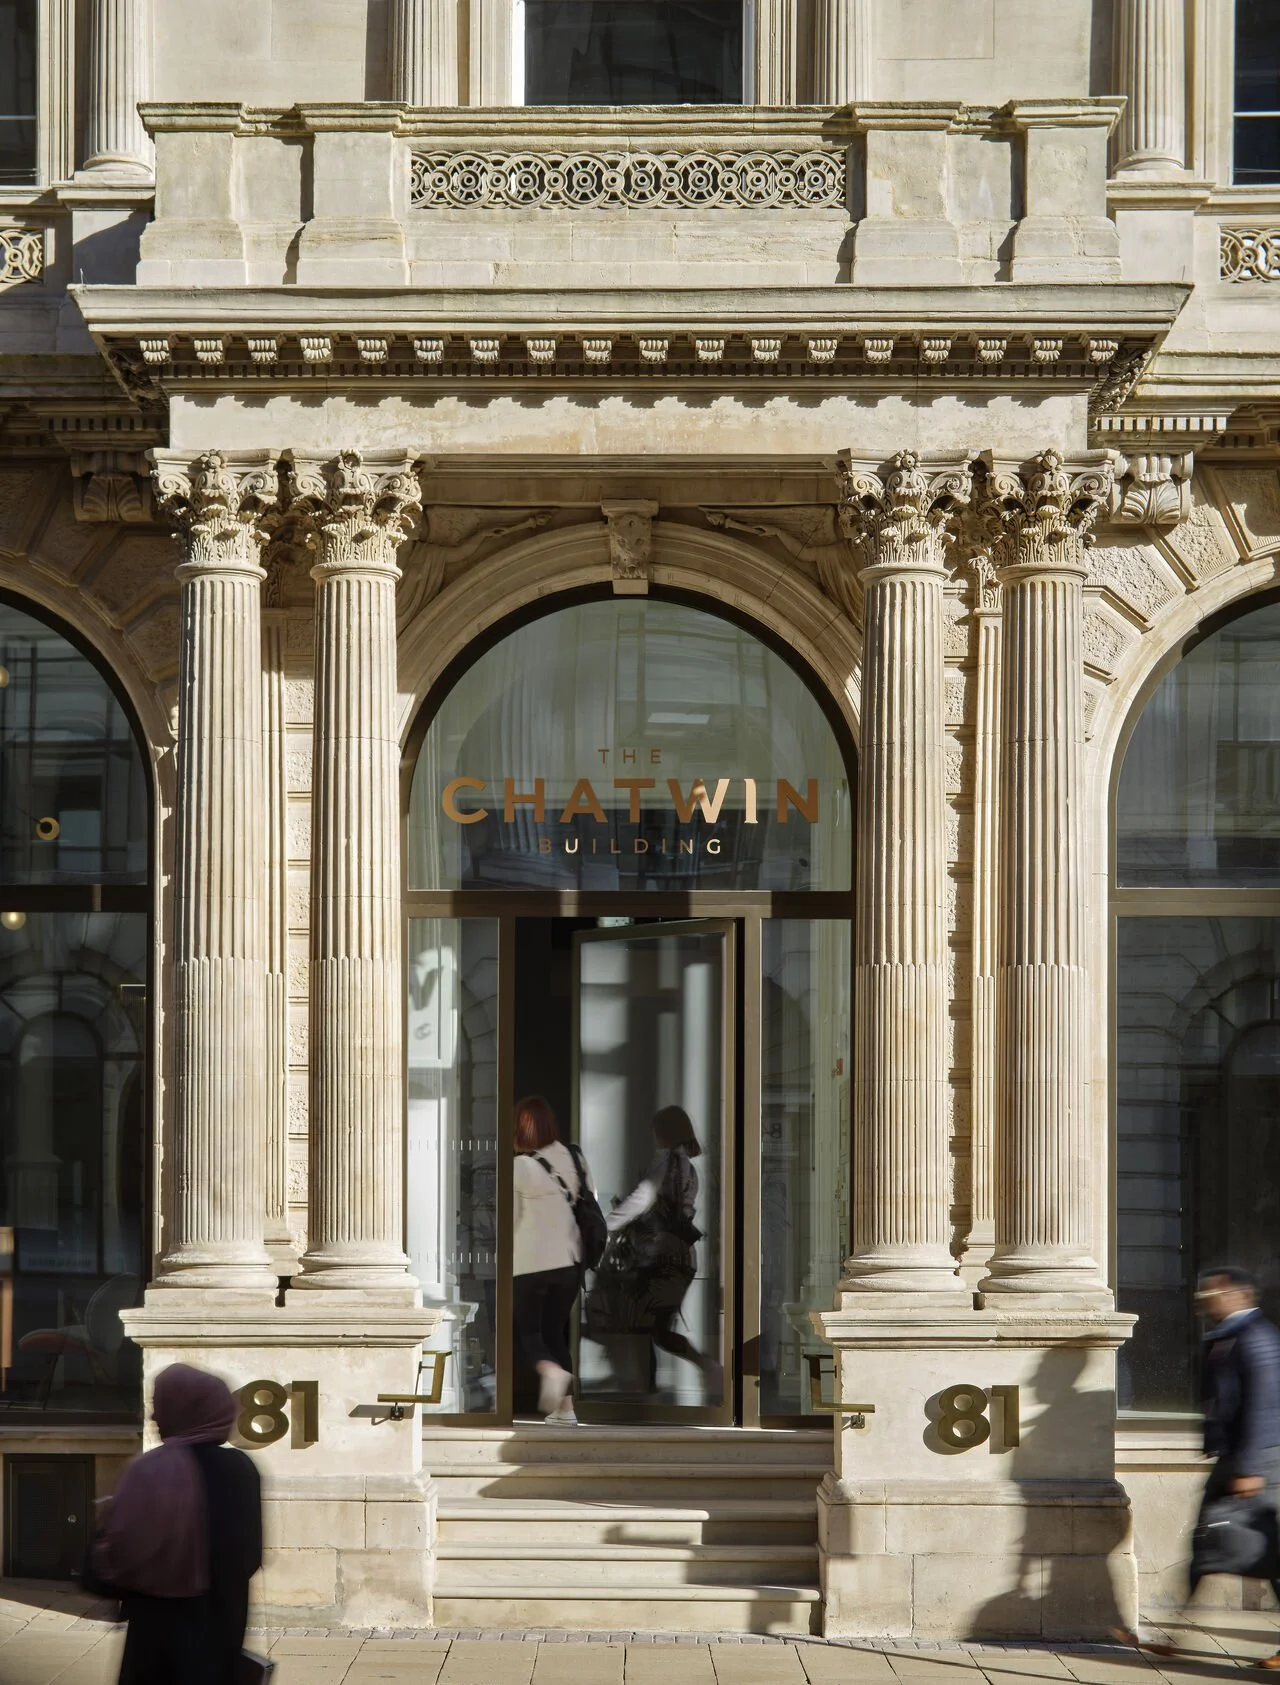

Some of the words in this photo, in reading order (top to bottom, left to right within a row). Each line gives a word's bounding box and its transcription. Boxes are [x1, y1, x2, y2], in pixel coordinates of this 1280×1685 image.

[598, 749, 662, 764] THE
[442, 776, 819, 825] CHATWIN
[538, 838, 722, 855] BUILDING
[237, 1379, 319, 1444] 81
[937, 1383, 1019, 1449] 81
